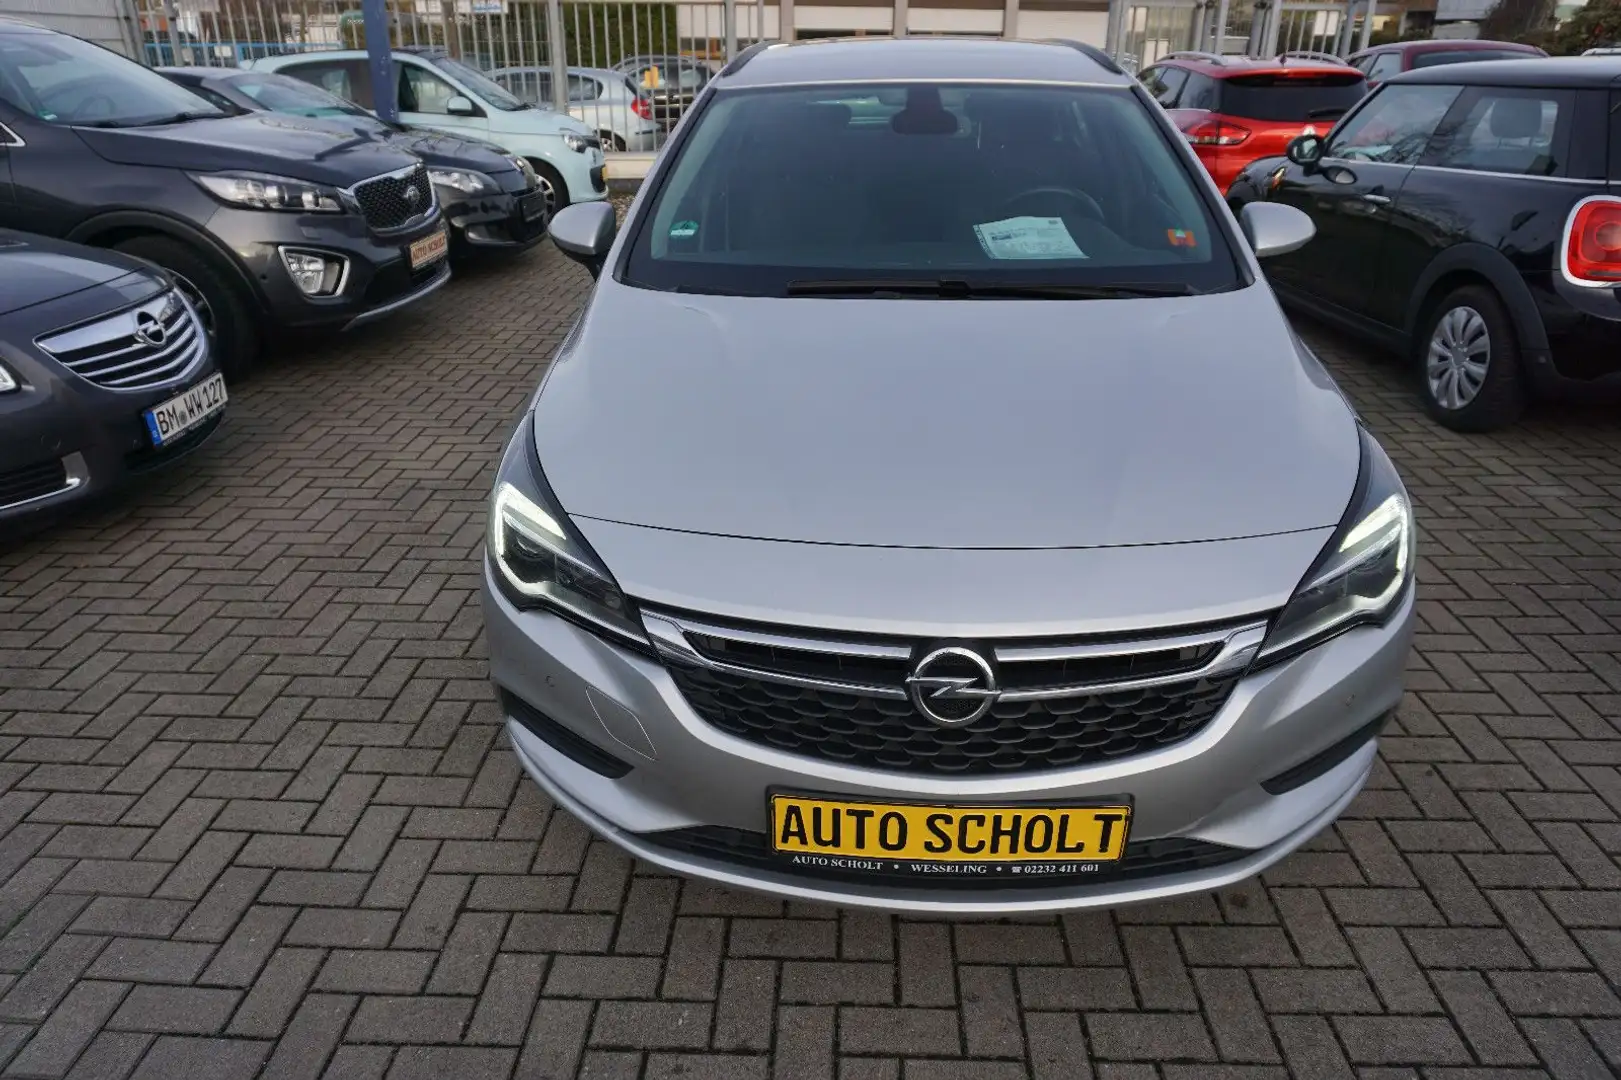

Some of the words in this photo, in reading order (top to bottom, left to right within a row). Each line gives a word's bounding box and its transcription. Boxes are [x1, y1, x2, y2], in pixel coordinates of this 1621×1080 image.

[156, 404, 180, 435] BM
[781, 804, 908, 852] AUTO
[792, 855, 828, 866] AUTO
[831, 858, 883, 871] SCHOLT
[911, 863, 987, 874] WESSELING
[1024, 864, 1056, 874] 02232
[1059, 863, 1078, 873] 411
[1081, 863, 1100, 873] 601
